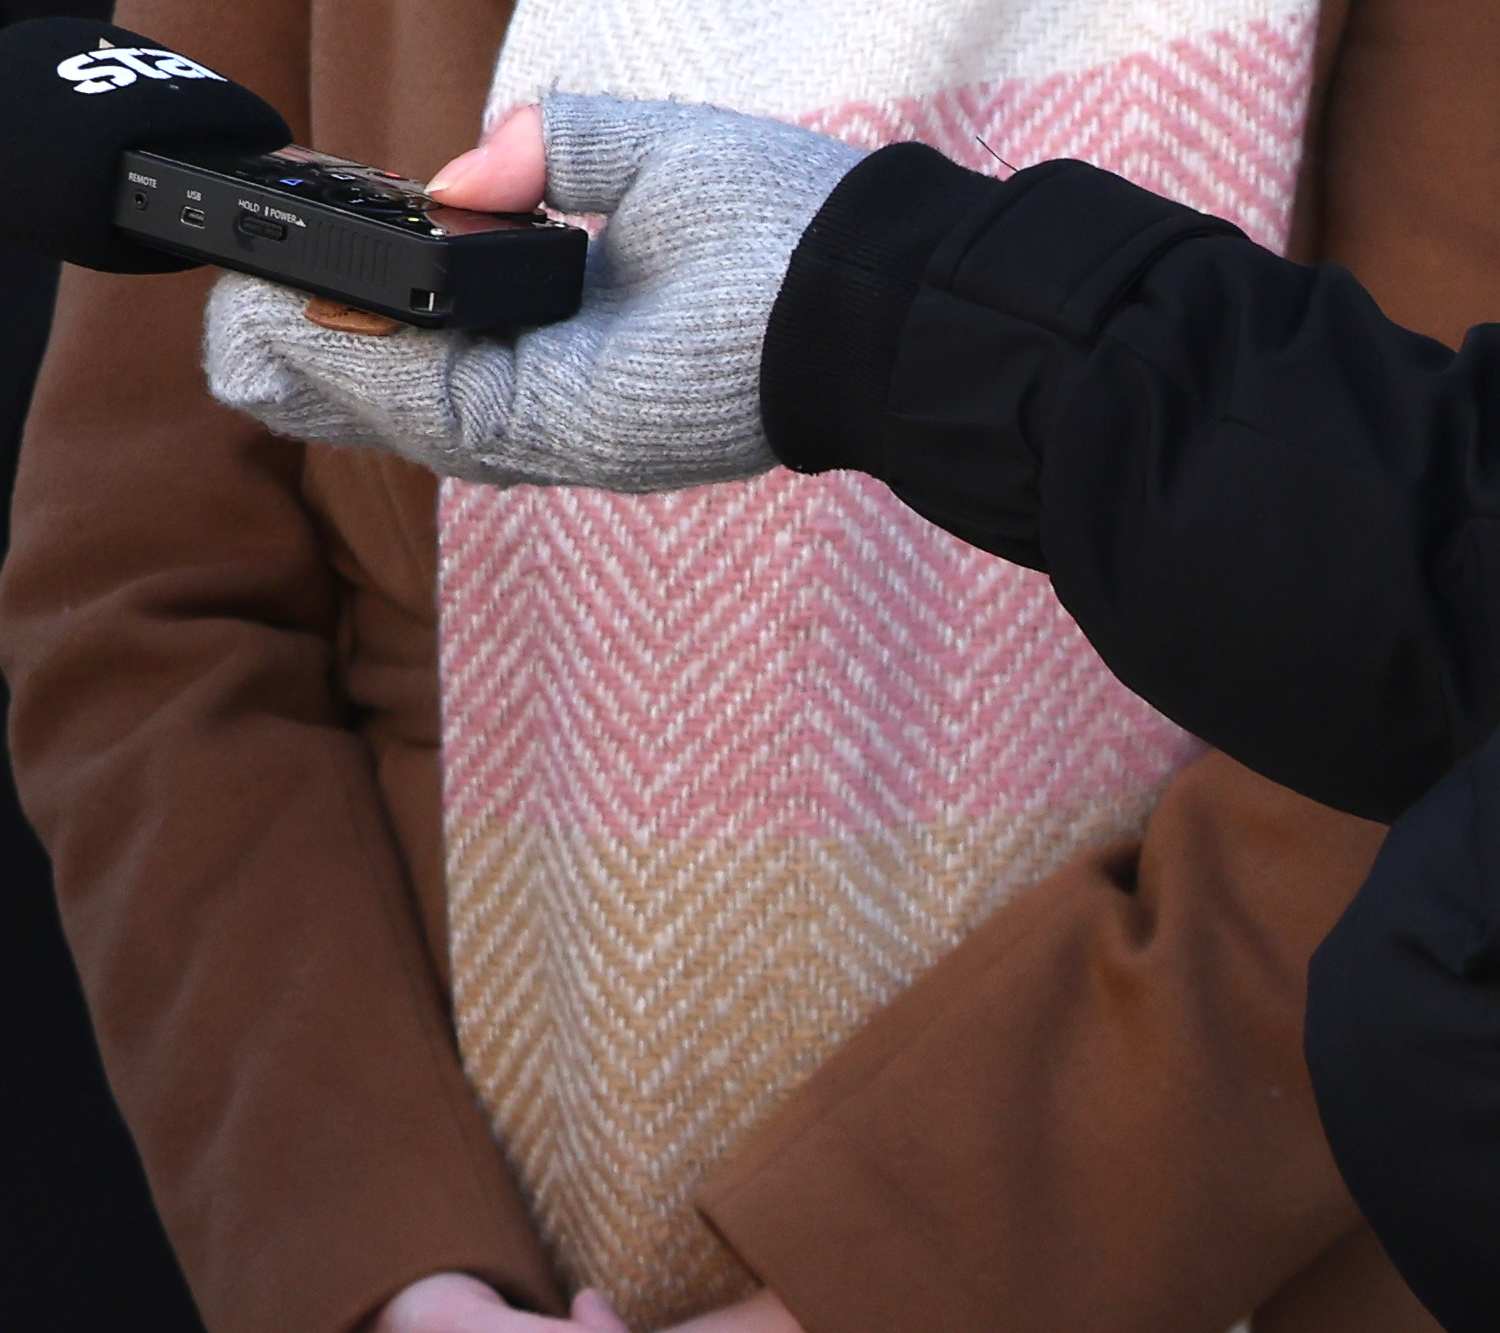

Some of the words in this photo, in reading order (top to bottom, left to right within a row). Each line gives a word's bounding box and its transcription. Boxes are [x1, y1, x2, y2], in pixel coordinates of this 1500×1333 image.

[128, 171, 157, 188] REMOTE
[186, 190, 202, 202] USB
[238, 199, 261, 213] HOLD
[269, 208, 297, 223] POWER
